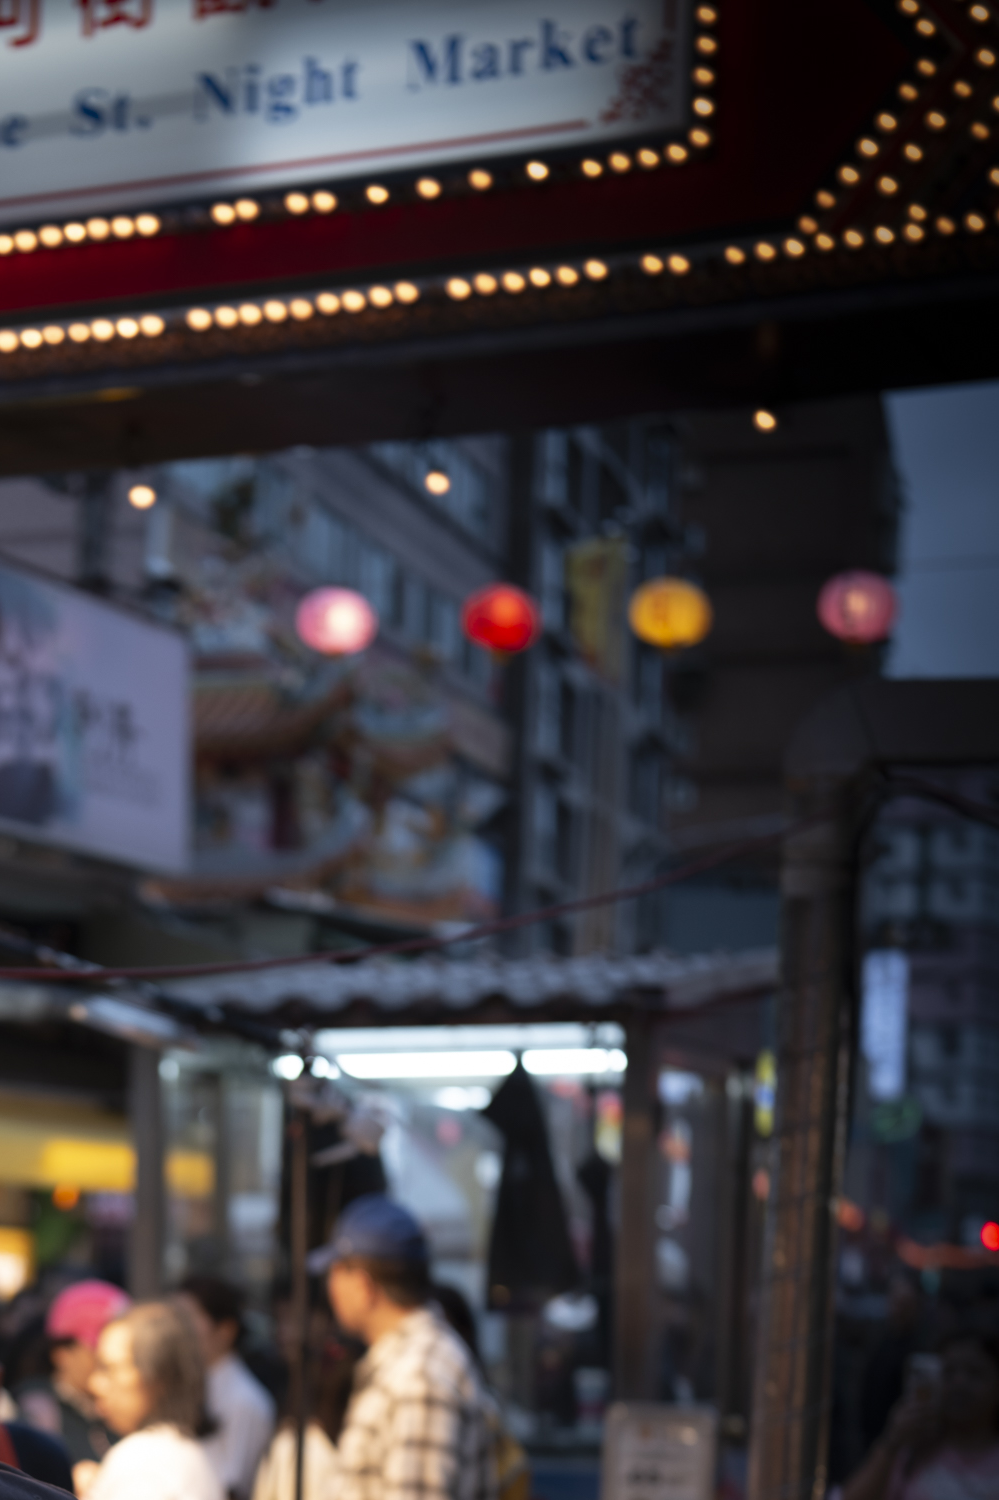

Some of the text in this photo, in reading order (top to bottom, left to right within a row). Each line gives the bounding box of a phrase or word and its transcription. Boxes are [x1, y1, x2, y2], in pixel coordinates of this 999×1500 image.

[69, 87, 154, 138] St.
[195, 55, 360, 126] Night
[407, 14, 643, 92] Market
